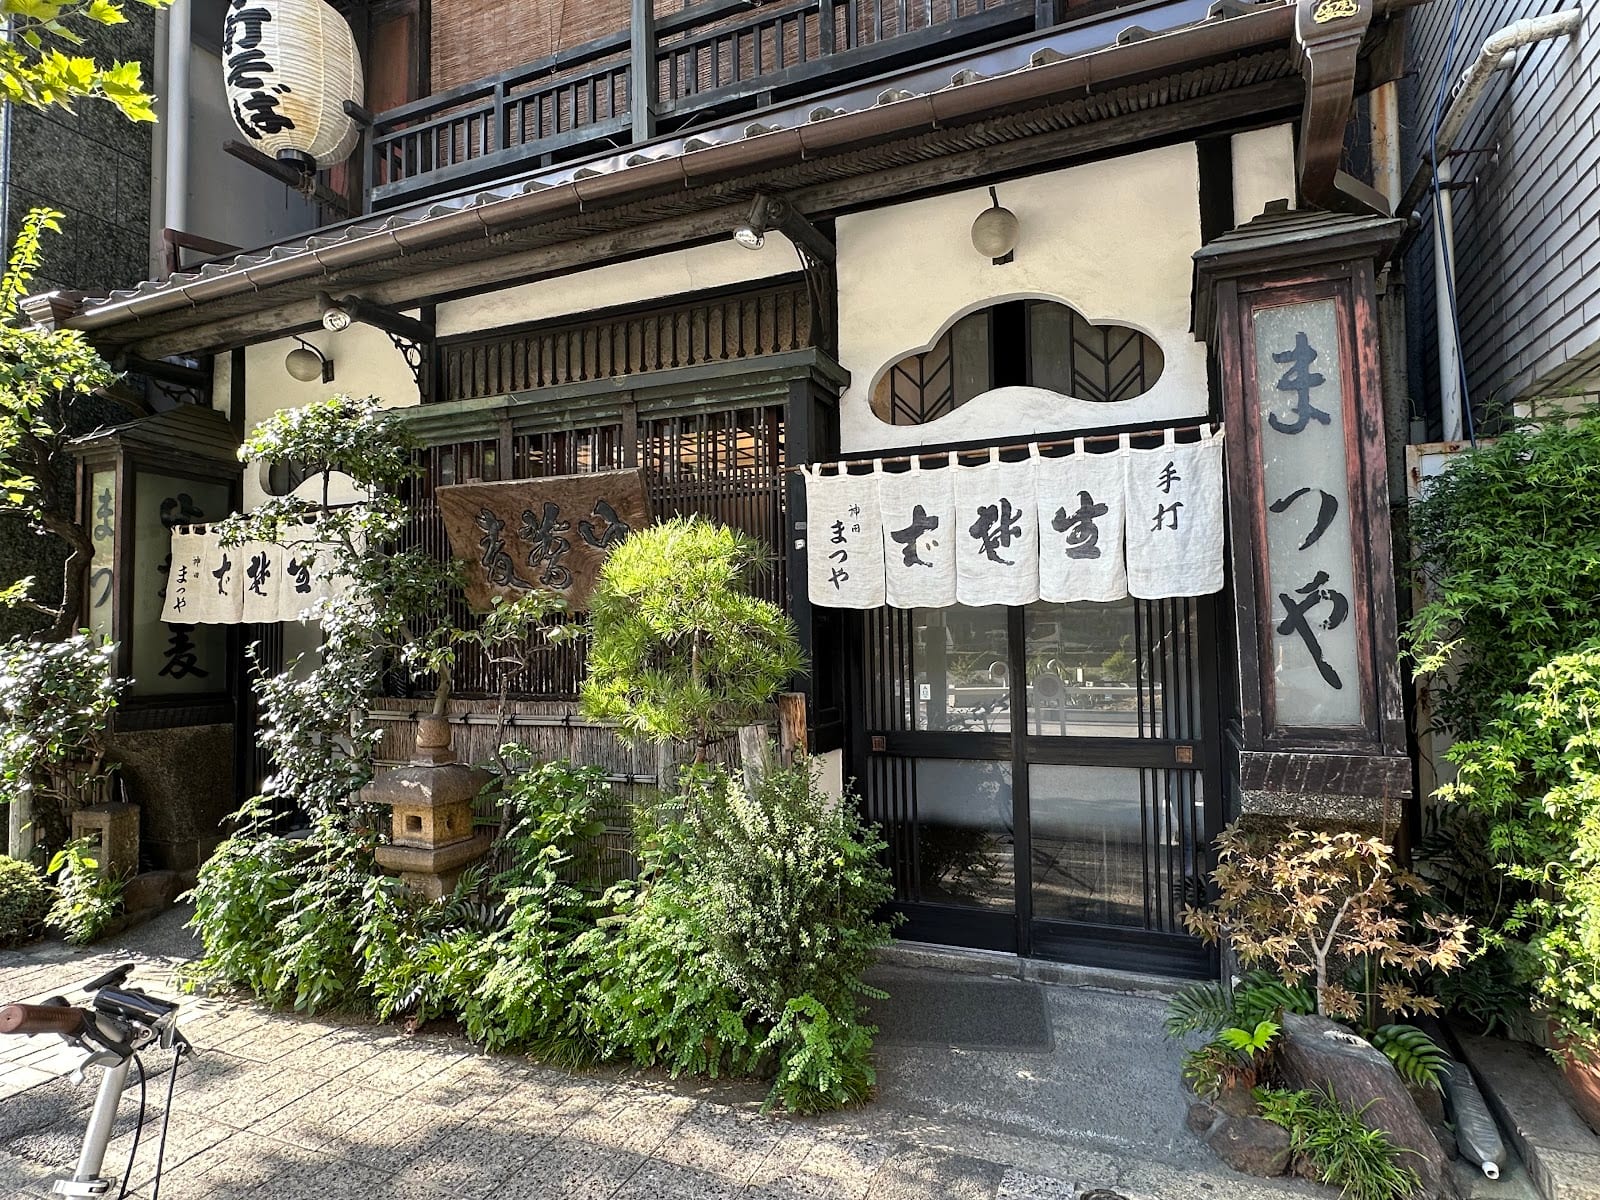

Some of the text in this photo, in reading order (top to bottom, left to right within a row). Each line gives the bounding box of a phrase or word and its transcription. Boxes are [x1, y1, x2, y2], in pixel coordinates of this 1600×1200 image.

[848, 503, 862, 534] 神田
[1150, 460, 1184, 533] 手打
[1268, 331, 1350, 691] まつや
[91, 487, 114, 620] まつ
[173, 564, 187, 613] まつや
[827, 519, 850, 592] まつや
